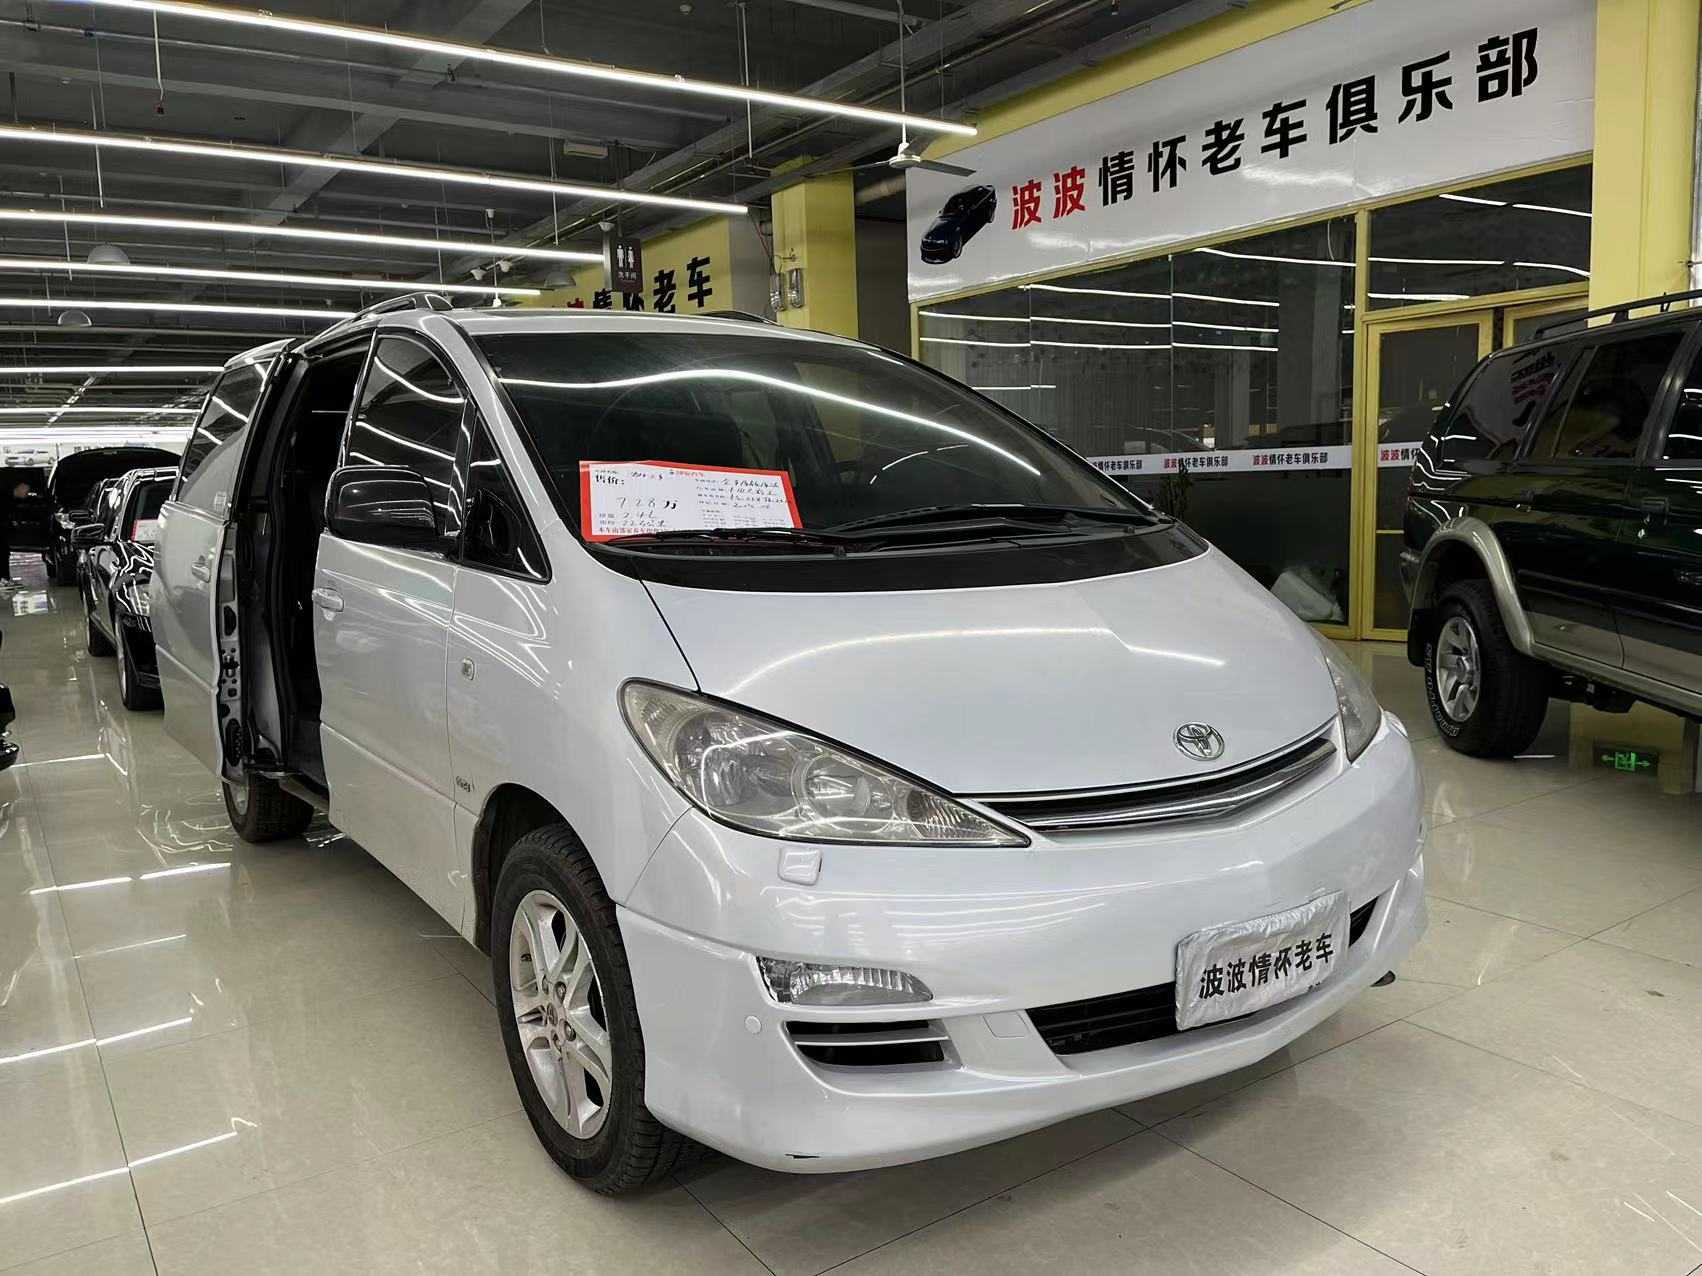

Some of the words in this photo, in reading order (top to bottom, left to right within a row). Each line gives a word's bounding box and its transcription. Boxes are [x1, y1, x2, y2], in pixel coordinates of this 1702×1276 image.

[1010, 26, 1539, 231] 波波情怀老车俱乐部
[1252, 452, 1329, 466] 波波情怀老车俱乐部
[1198, 932, 1334, 1000] 波波情怀老车
